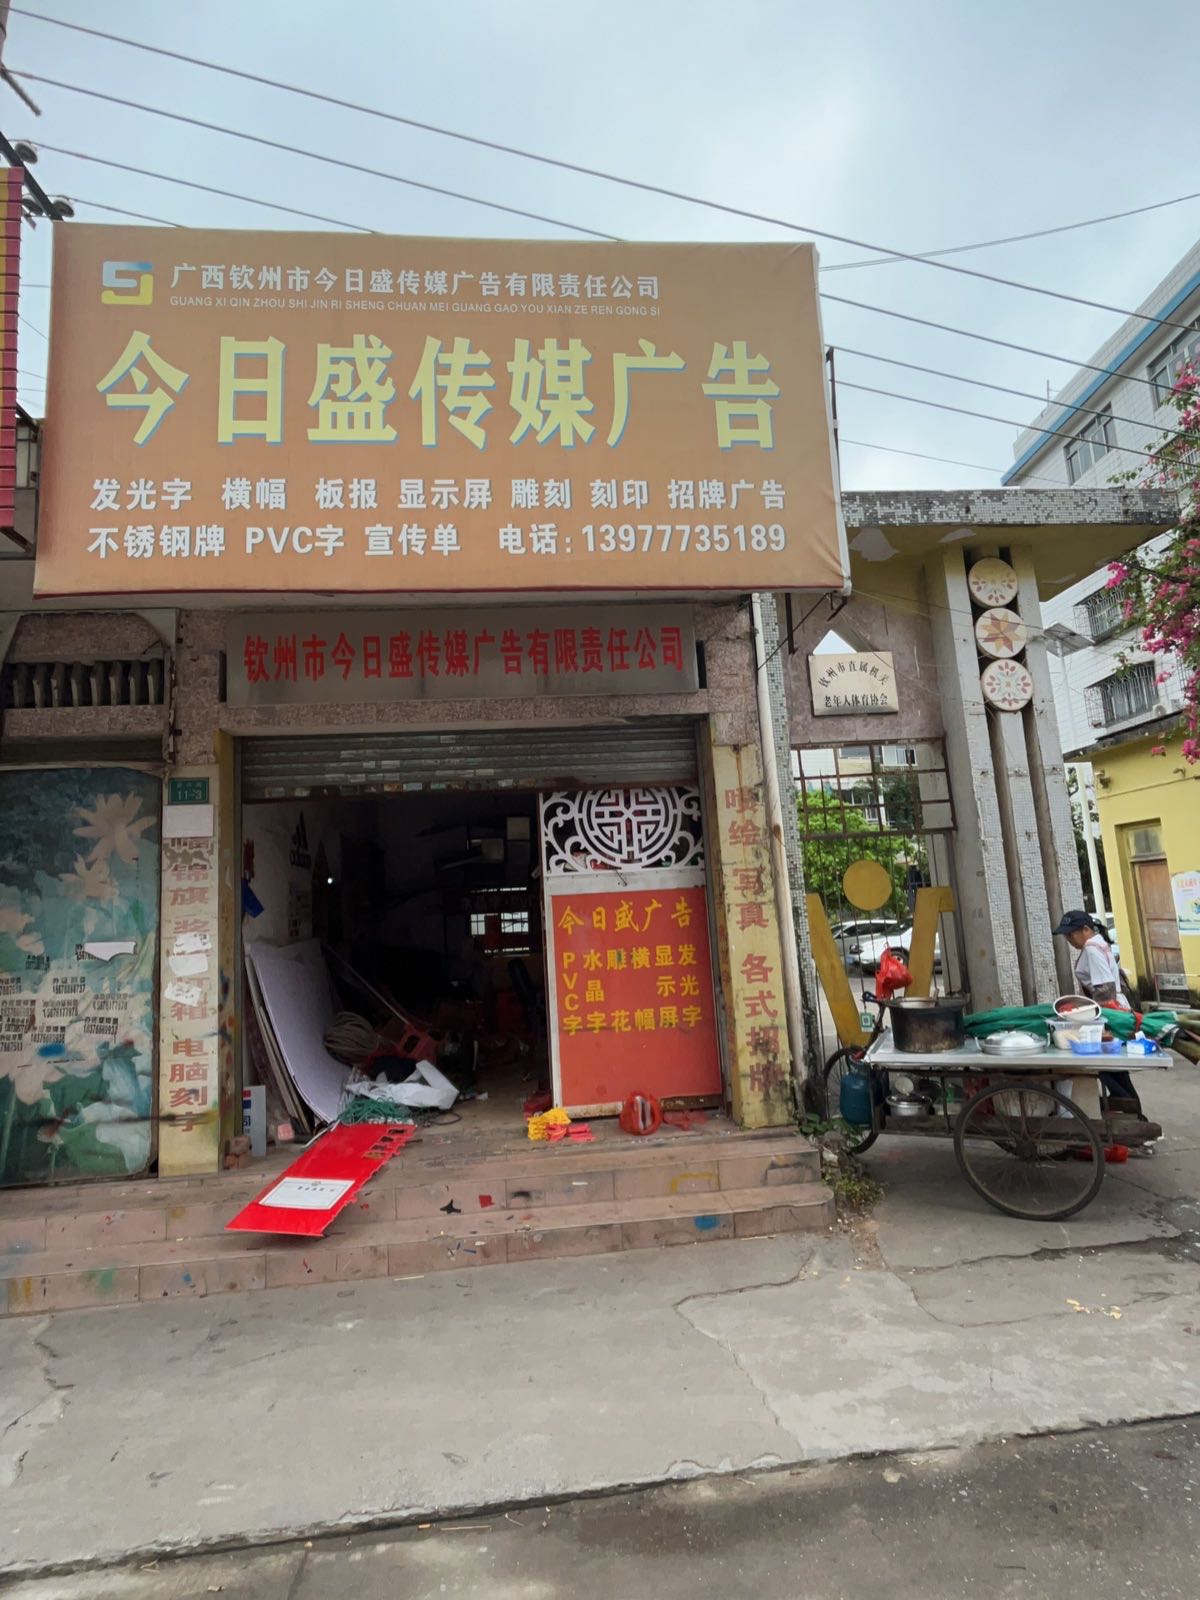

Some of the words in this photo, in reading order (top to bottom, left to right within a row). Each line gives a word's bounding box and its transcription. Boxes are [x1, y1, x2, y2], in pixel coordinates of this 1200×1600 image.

[171, 262, 660, 300] 广西钦州市今日盛传媒广告有限责任公司
[170, 295, 213, 307] GUANG
[215, 296, 227, 307] XI
[229, 296, 250, 308] QIN
[253, 297, 286, 309] ZHOU
[288, 298, 308, 310] SHI
[310, 299, 330, 310] JIN
[331, 299, 342, 310] RI
[346, 300, 385, 312] SHENG
[387, 301, 427, 313] CHUAN
[429, 302, 449, 313] MEI
[452, 303, 492, 314] GUANG
[494, 303, 518, 314] GAO
[519, 304, 544, 315] YOU
[546, 304, 572, 315] XIAN
[574, 305, 588, 316] ZE
[590, 305, 613, 316] REN
[615, 306, 648, 317] GONG
[650, 307, 661, 318] SI
[96, 330, 781, 449] 今日盛传媒广告
[89, 478, 193, 511] 发光字
[221, 477, 287, 511] 横幅
[315, 477, 378, 510] 板报
[397, 478, 493, 511] 显示屏
[510, 478, 572, 510] 雕刻
[589, 479, 649, 511] 刻印
[667, 479, 787, 511] 招牌广告
[87, 525, 226, 559] 不锈钢牌
[245, 525, 345, 557] PVC字
[364, 524, 461, 557] 宣传单
[243, 626, 684, 683] 钦州市今日盛传媒广告有限责任公司
[818, 660, 889, 688] 钦州市直属机关
[824, 692, 888, 708] 老年人体育协会
[557, 896, 694, 936] 今日盛广告
